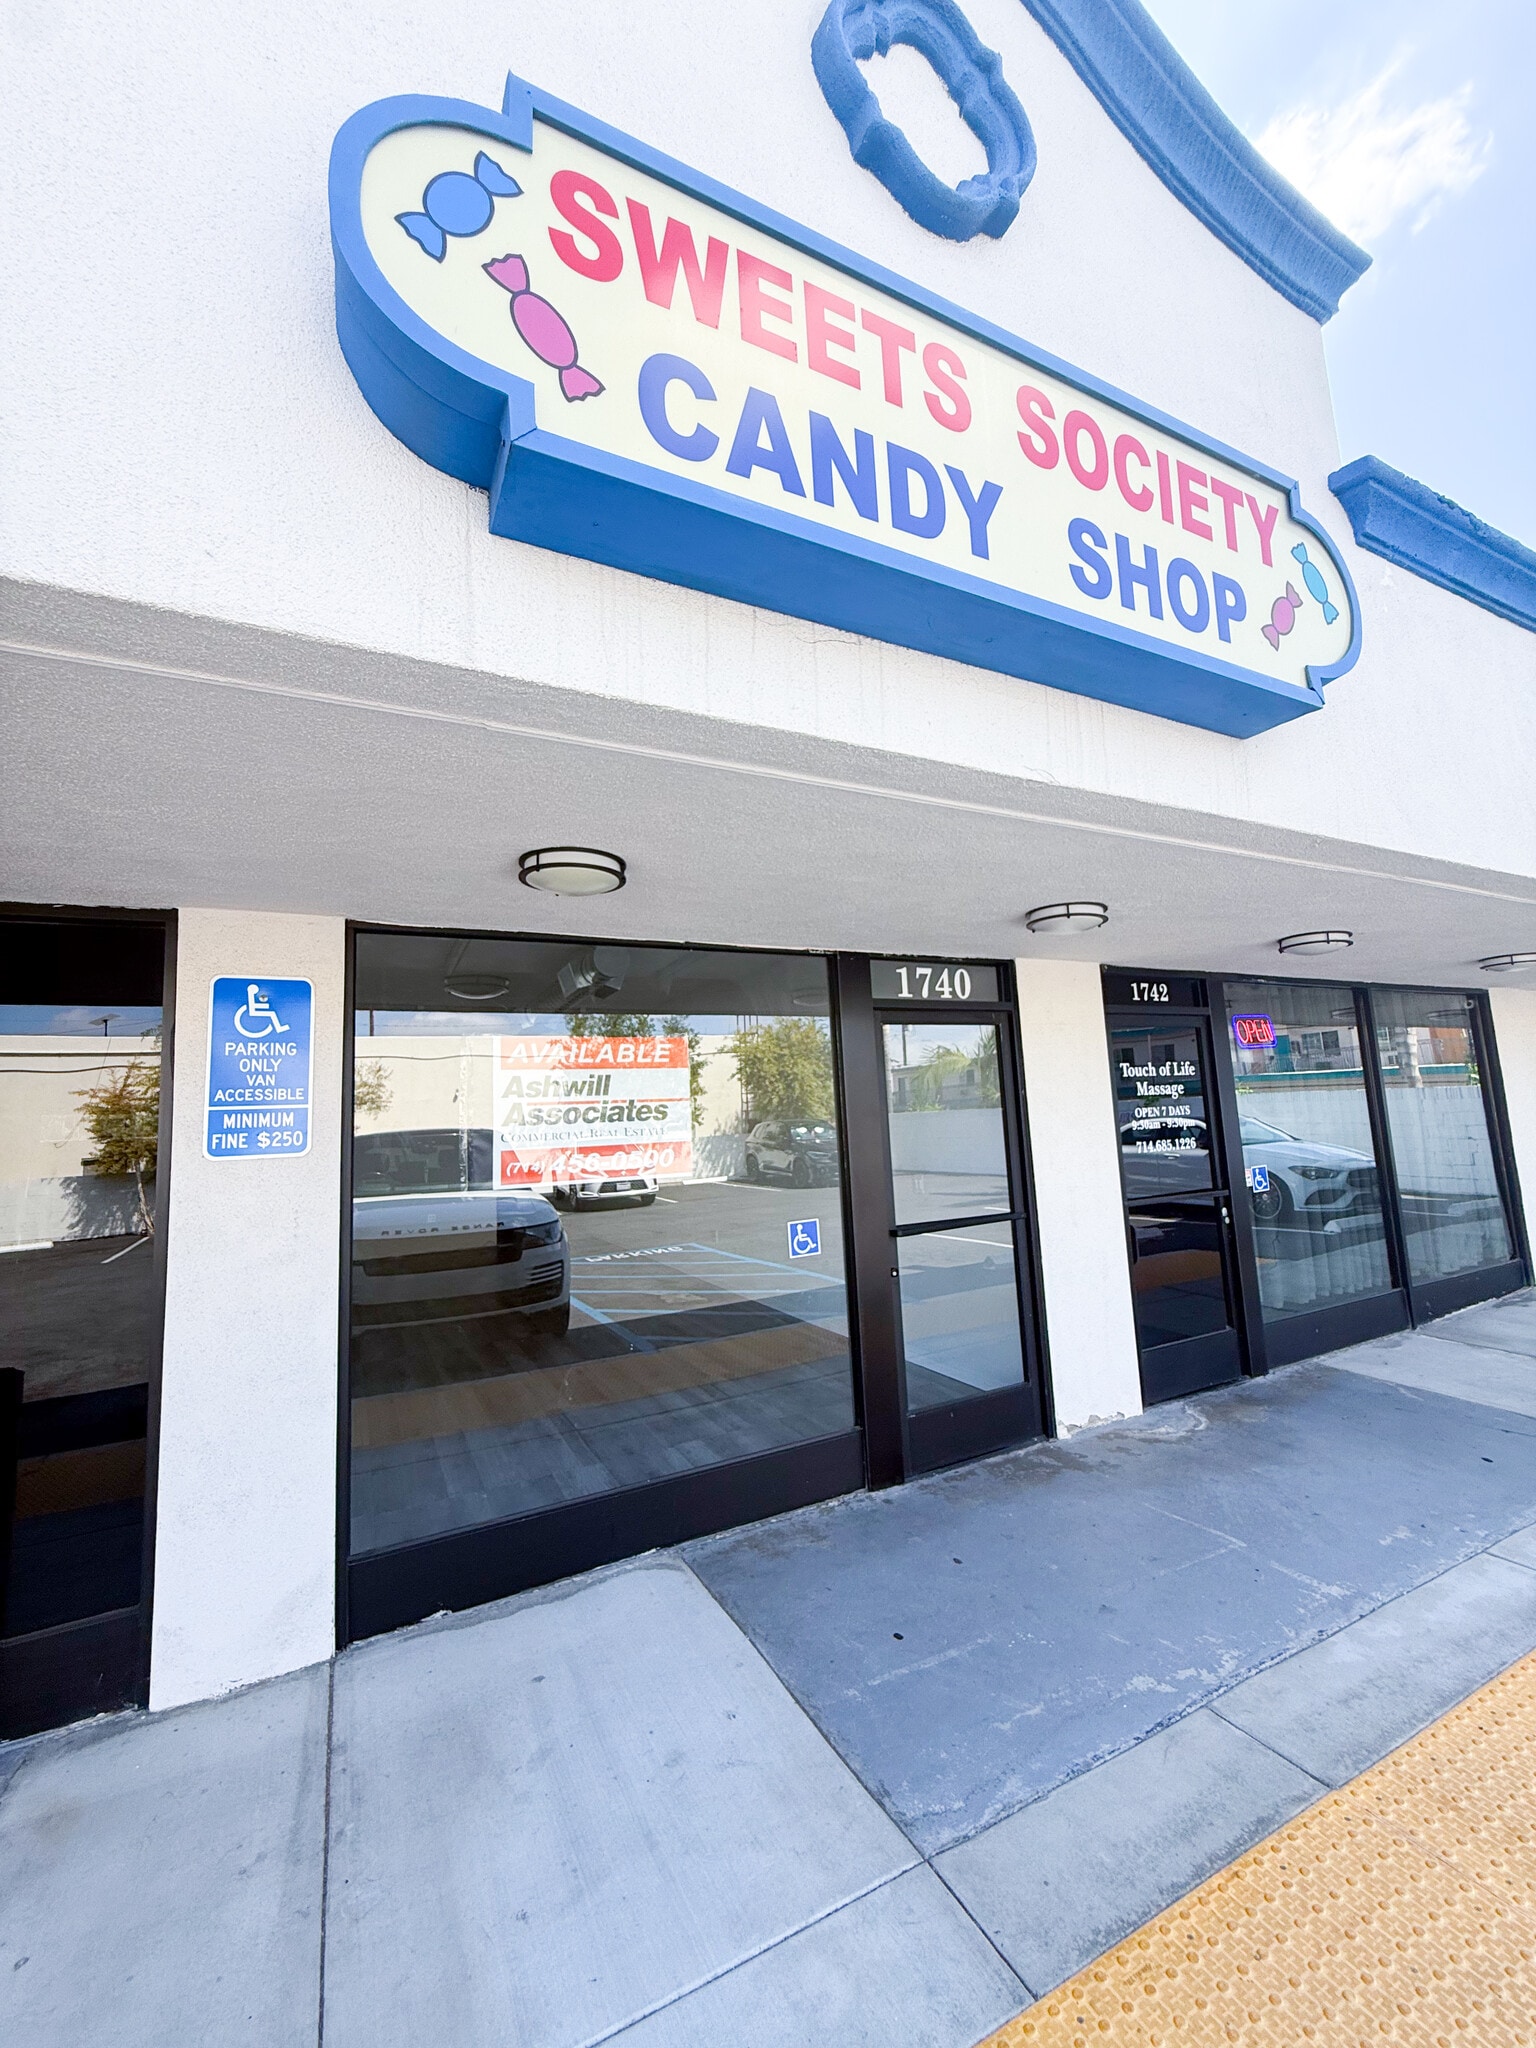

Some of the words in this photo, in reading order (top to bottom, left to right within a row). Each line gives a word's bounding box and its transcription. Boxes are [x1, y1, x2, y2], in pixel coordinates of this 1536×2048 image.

[548, 169, 973, 433] SWEETS
[1015, 385, 1280, 569] SOCIETY
[637, 352, 1004, 560] CANDY
[1068, 517, 1247, 643] SHOP
[896, 966, 972, 1000] 1740
[1131, 982, 1169, 1002] 1742
[1236, 1019, 1274, 1044] OPEN
[225, 1042, 297, 1056] PARKING
[507, 1043, 672, 1064] AVAILABLE
[239, 1058, 282, 1073] ONLY
[1119, 1062, 1157, 1078] Touch
[1159, 1062, 1171, 1076] of
[1173, 1061, 1196, 1076] Life
[246, 1074, 276, 1087] VAN
[501, 1074, 611, 1099] Ashwill
[1136, 1081, 1185, 1099] Massage
[214, 1088, 305, 1102] ACCESSIBLE
[223, 1112, 294, 1129] MINIMUM
[501, 1099, 669, 1127] Associates
[1134, 1106, 1160, 1118] OPEN
[1161, 1106, 1167, 1116] 7
[1168, 1105, 1191, 1116] DAYS
[212, 1133, 248, 1150] FINE
[257, 1131, 303, 1149] $250
[1136, 1137, 1197, 1154] 714.685.1226
[506, 1161, 546, 1177] (714)
[551, 1148, 675, 1175] 456-0500
